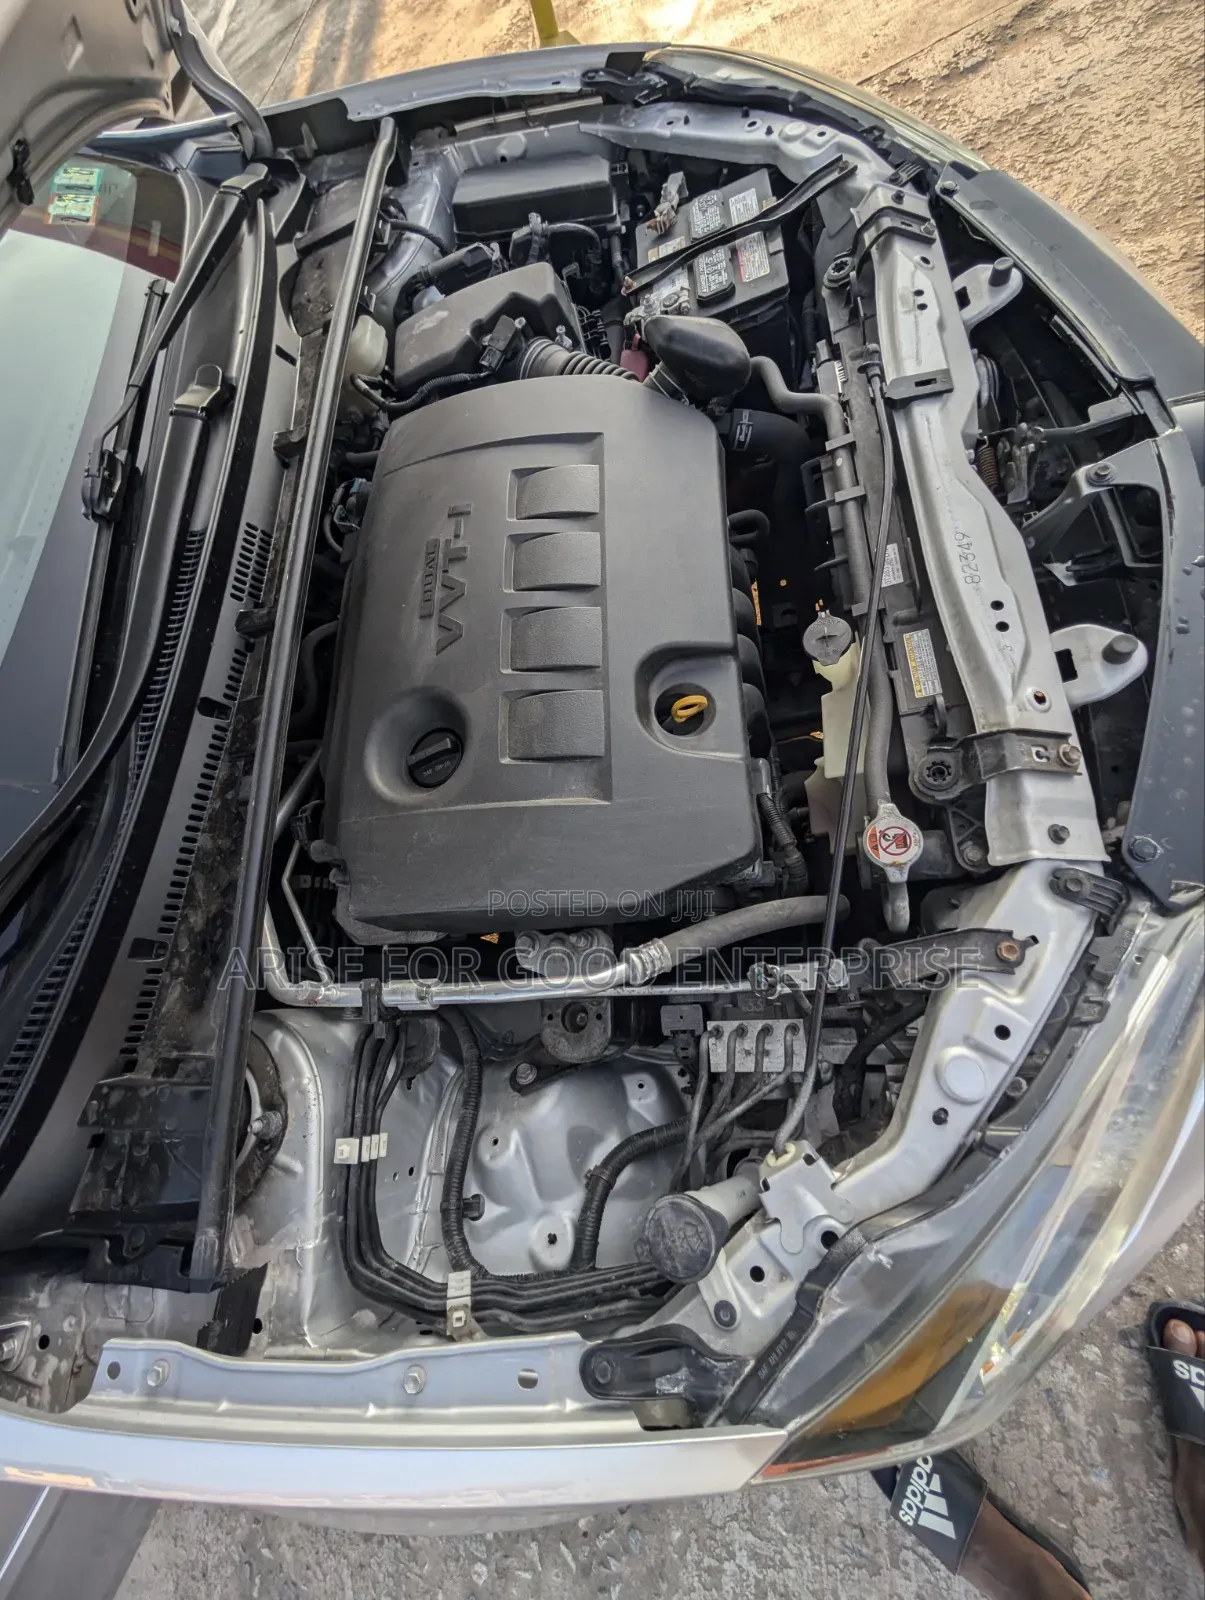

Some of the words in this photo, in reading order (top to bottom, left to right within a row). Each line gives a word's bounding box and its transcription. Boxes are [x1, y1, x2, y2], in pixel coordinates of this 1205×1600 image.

[423, 544, 437, 602] DUAL
[954, 532, 981, 584] 82349
[898, 1455, 933, 1526] adidas
